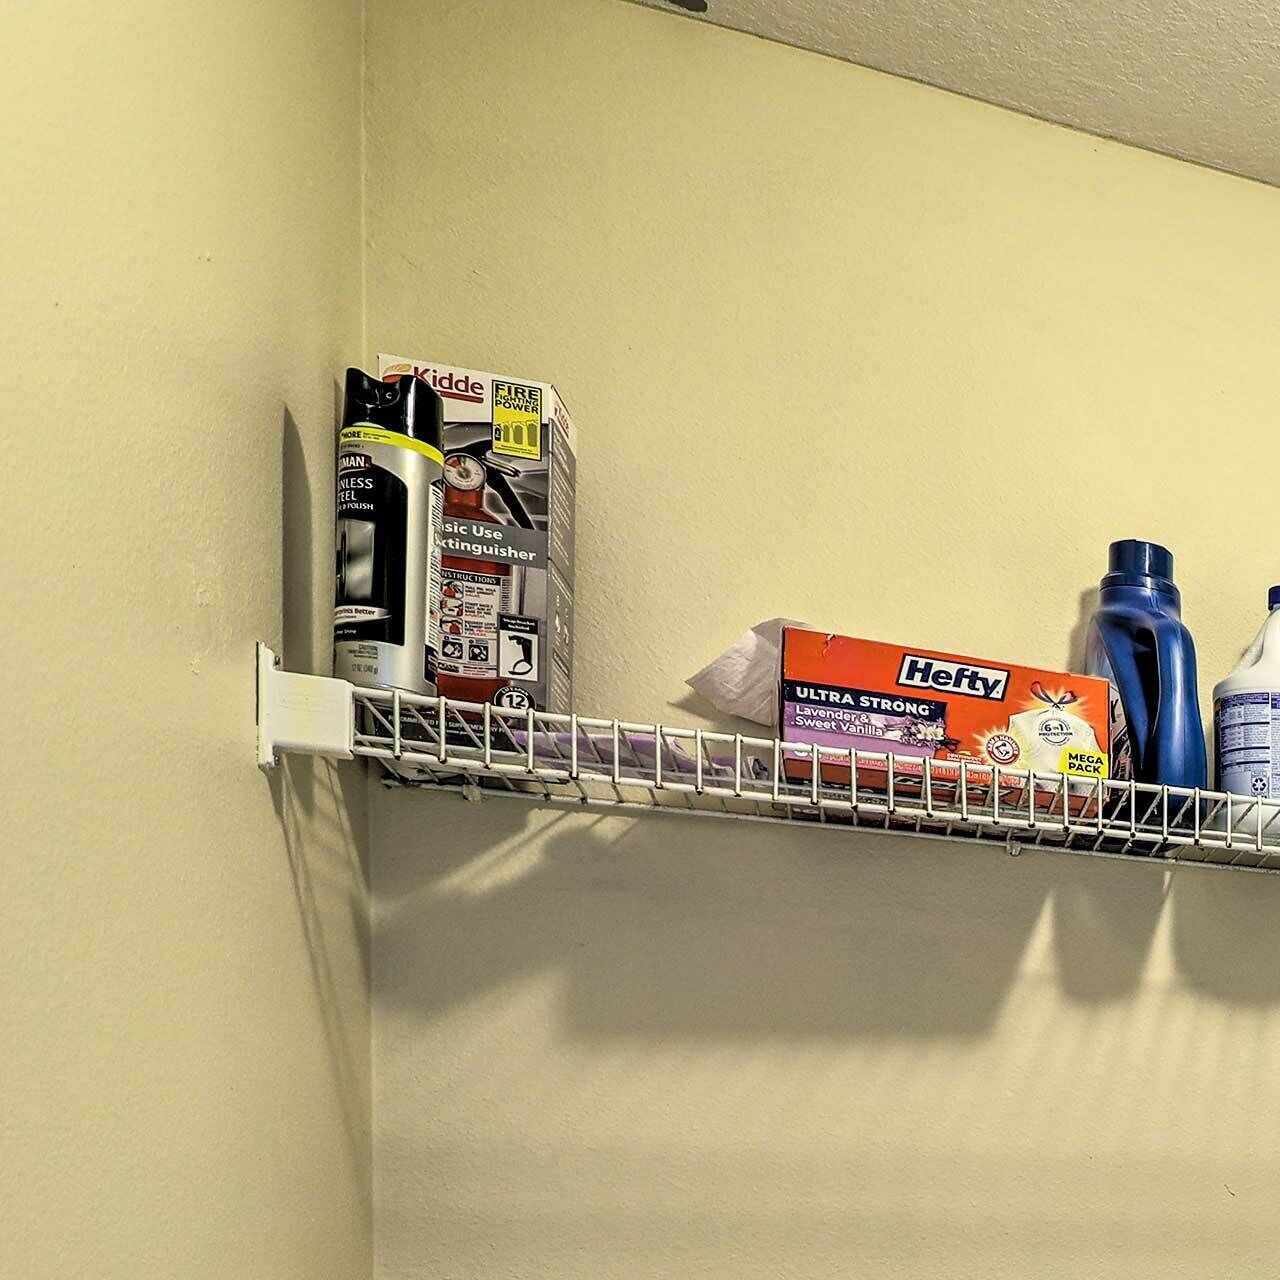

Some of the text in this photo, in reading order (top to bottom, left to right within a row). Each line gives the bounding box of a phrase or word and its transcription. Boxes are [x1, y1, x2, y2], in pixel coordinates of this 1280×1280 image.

[414, 366, 485, 396] Kidde
[494, 383, 539, 400] FIRE
[494, 393, 539, 406] FIGHTING
[494, 399, 539, 415] POWER
[472, 525, 503, 540] Use
[354, 607, 376, 616] Better
[905, 659, 1002, 697] Hefty
[505, 693, 526, 708] 12
[795, 686, 930, 716] ULTRA STRONG
[796, 704, 870, 724] Lavender &
[795, 717, 883, 737] Sweet Vanilla
[1044, 723, 1052, 732] 6
[1058, 723, 1064, 731] 1
[1067, 752, 1104, 766] MEGA
[1067, 761, 1101, 774] PACK
